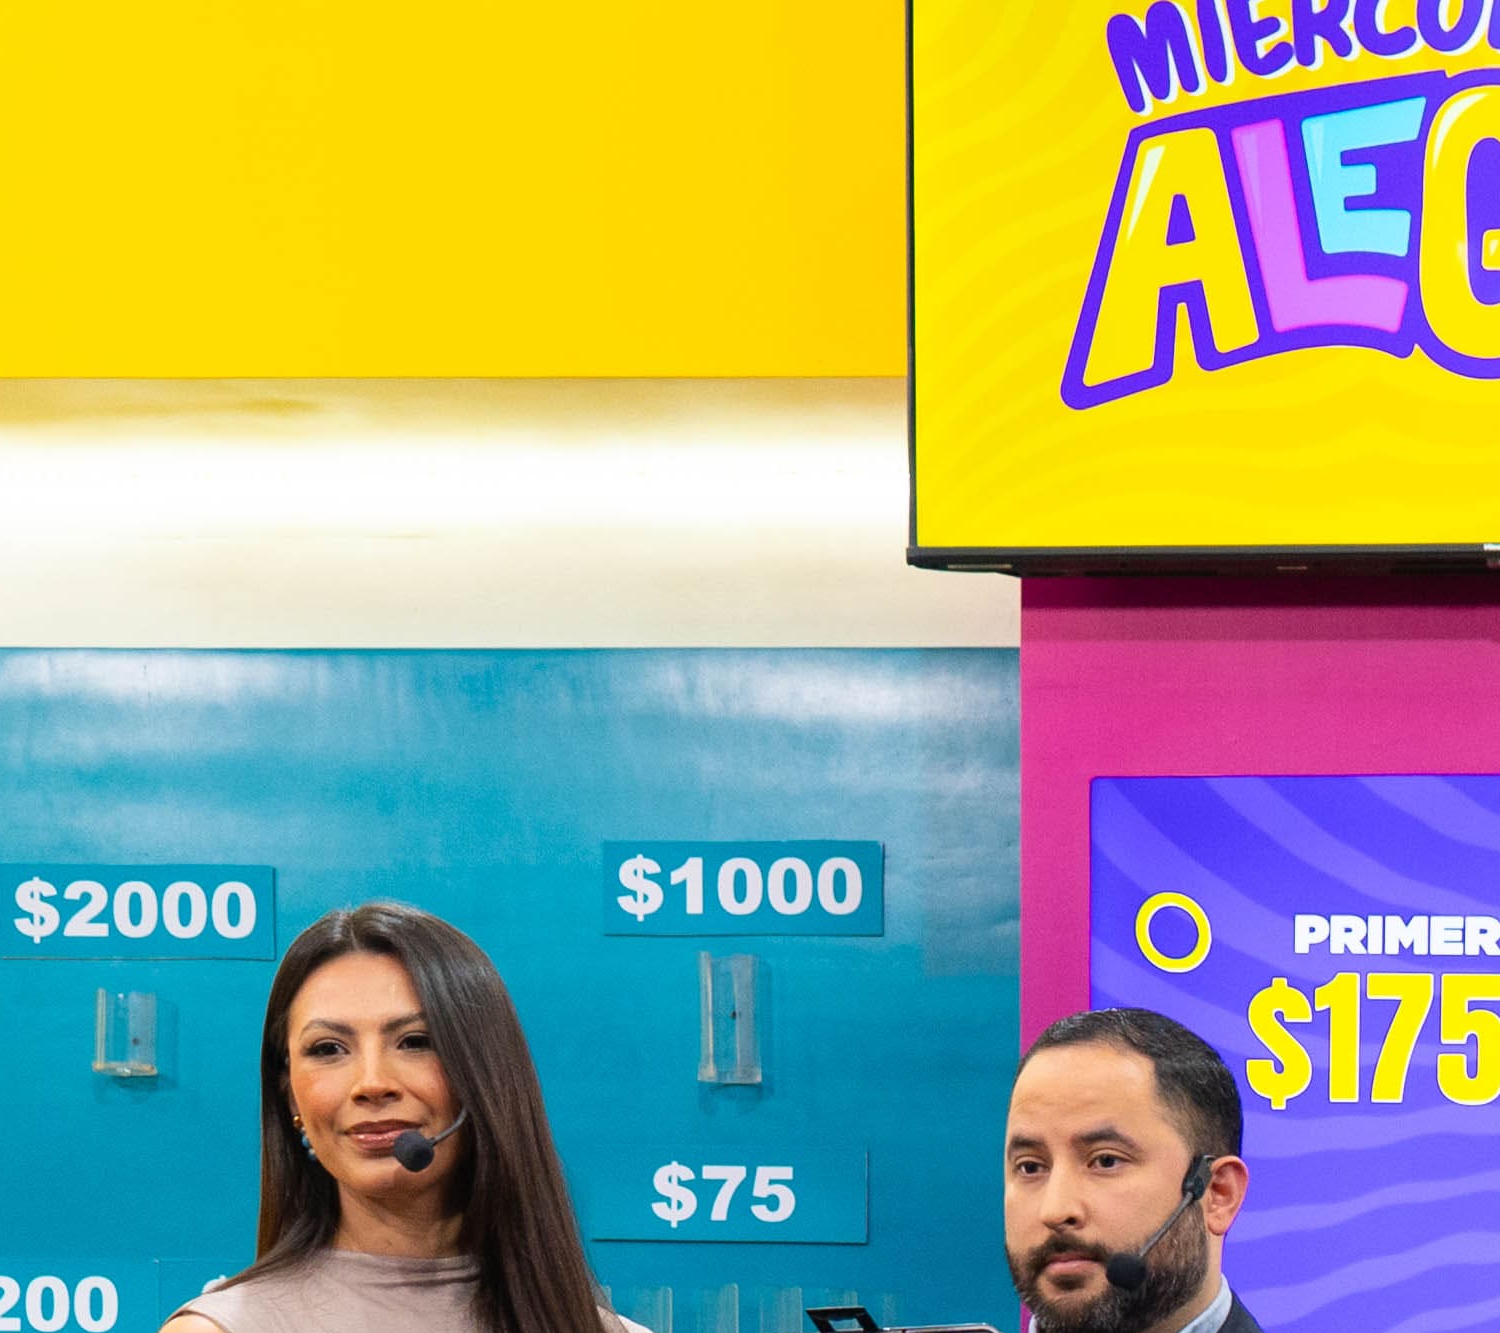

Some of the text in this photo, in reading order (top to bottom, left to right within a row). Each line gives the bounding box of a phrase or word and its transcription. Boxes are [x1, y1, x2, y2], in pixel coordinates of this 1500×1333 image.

[14, 876, 258, 945] $2000
[617, 853, 864, 922] $1000
[651, 1161, 797, 1228] $75
